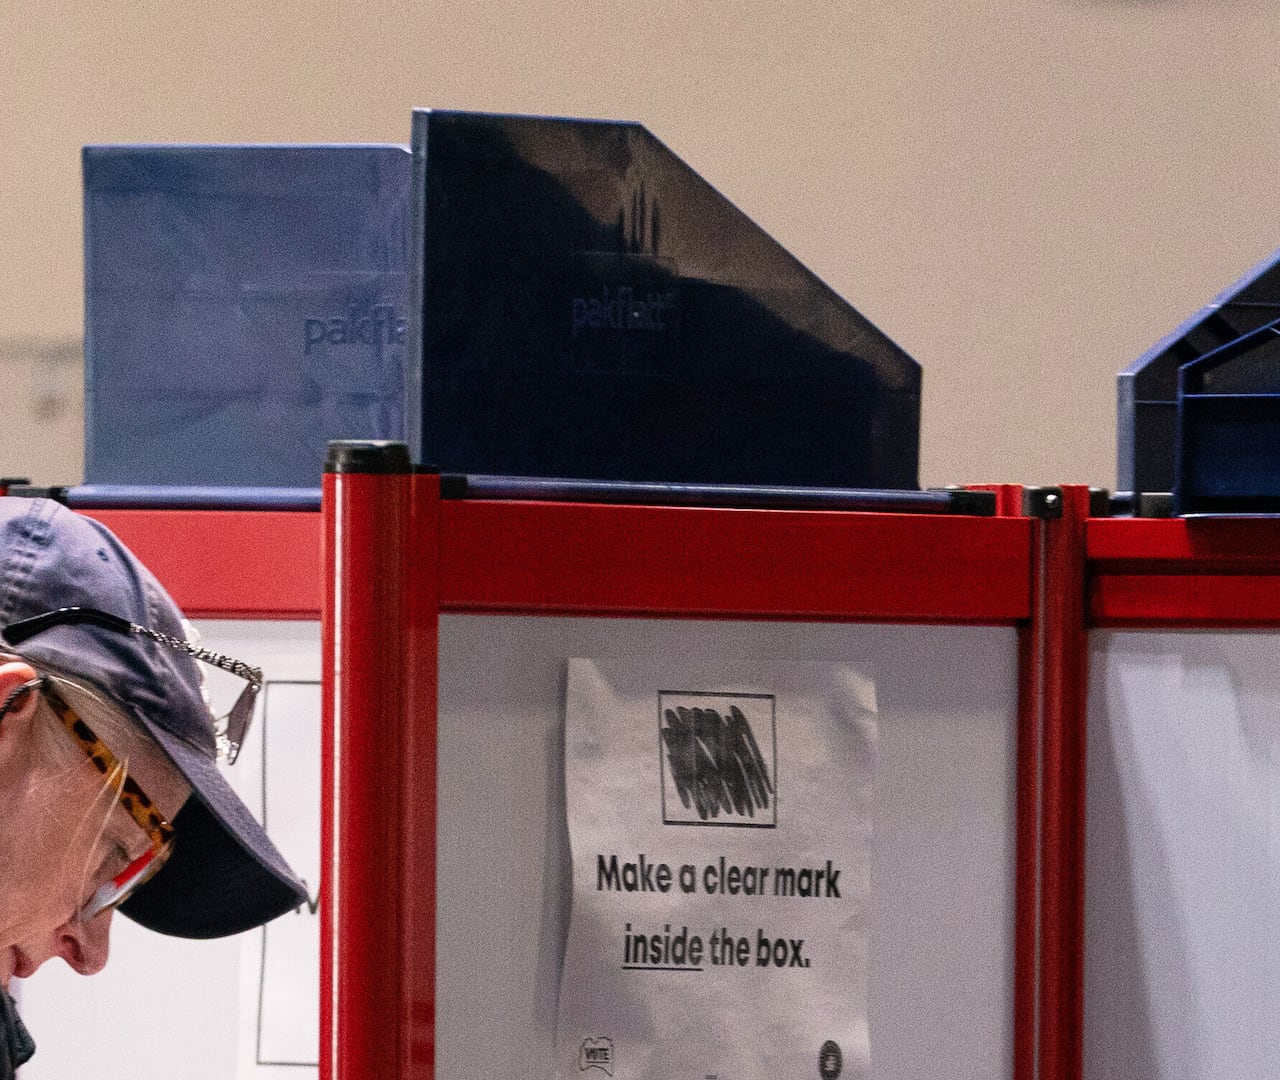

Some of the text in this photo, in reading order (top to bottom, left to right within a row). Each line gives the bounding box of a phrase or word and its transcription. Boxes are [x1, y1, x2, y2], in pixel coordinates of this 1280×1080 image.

[596, 854, 842, 899] Make a clear mark
[624, 923, 812, 968] inside the box.
